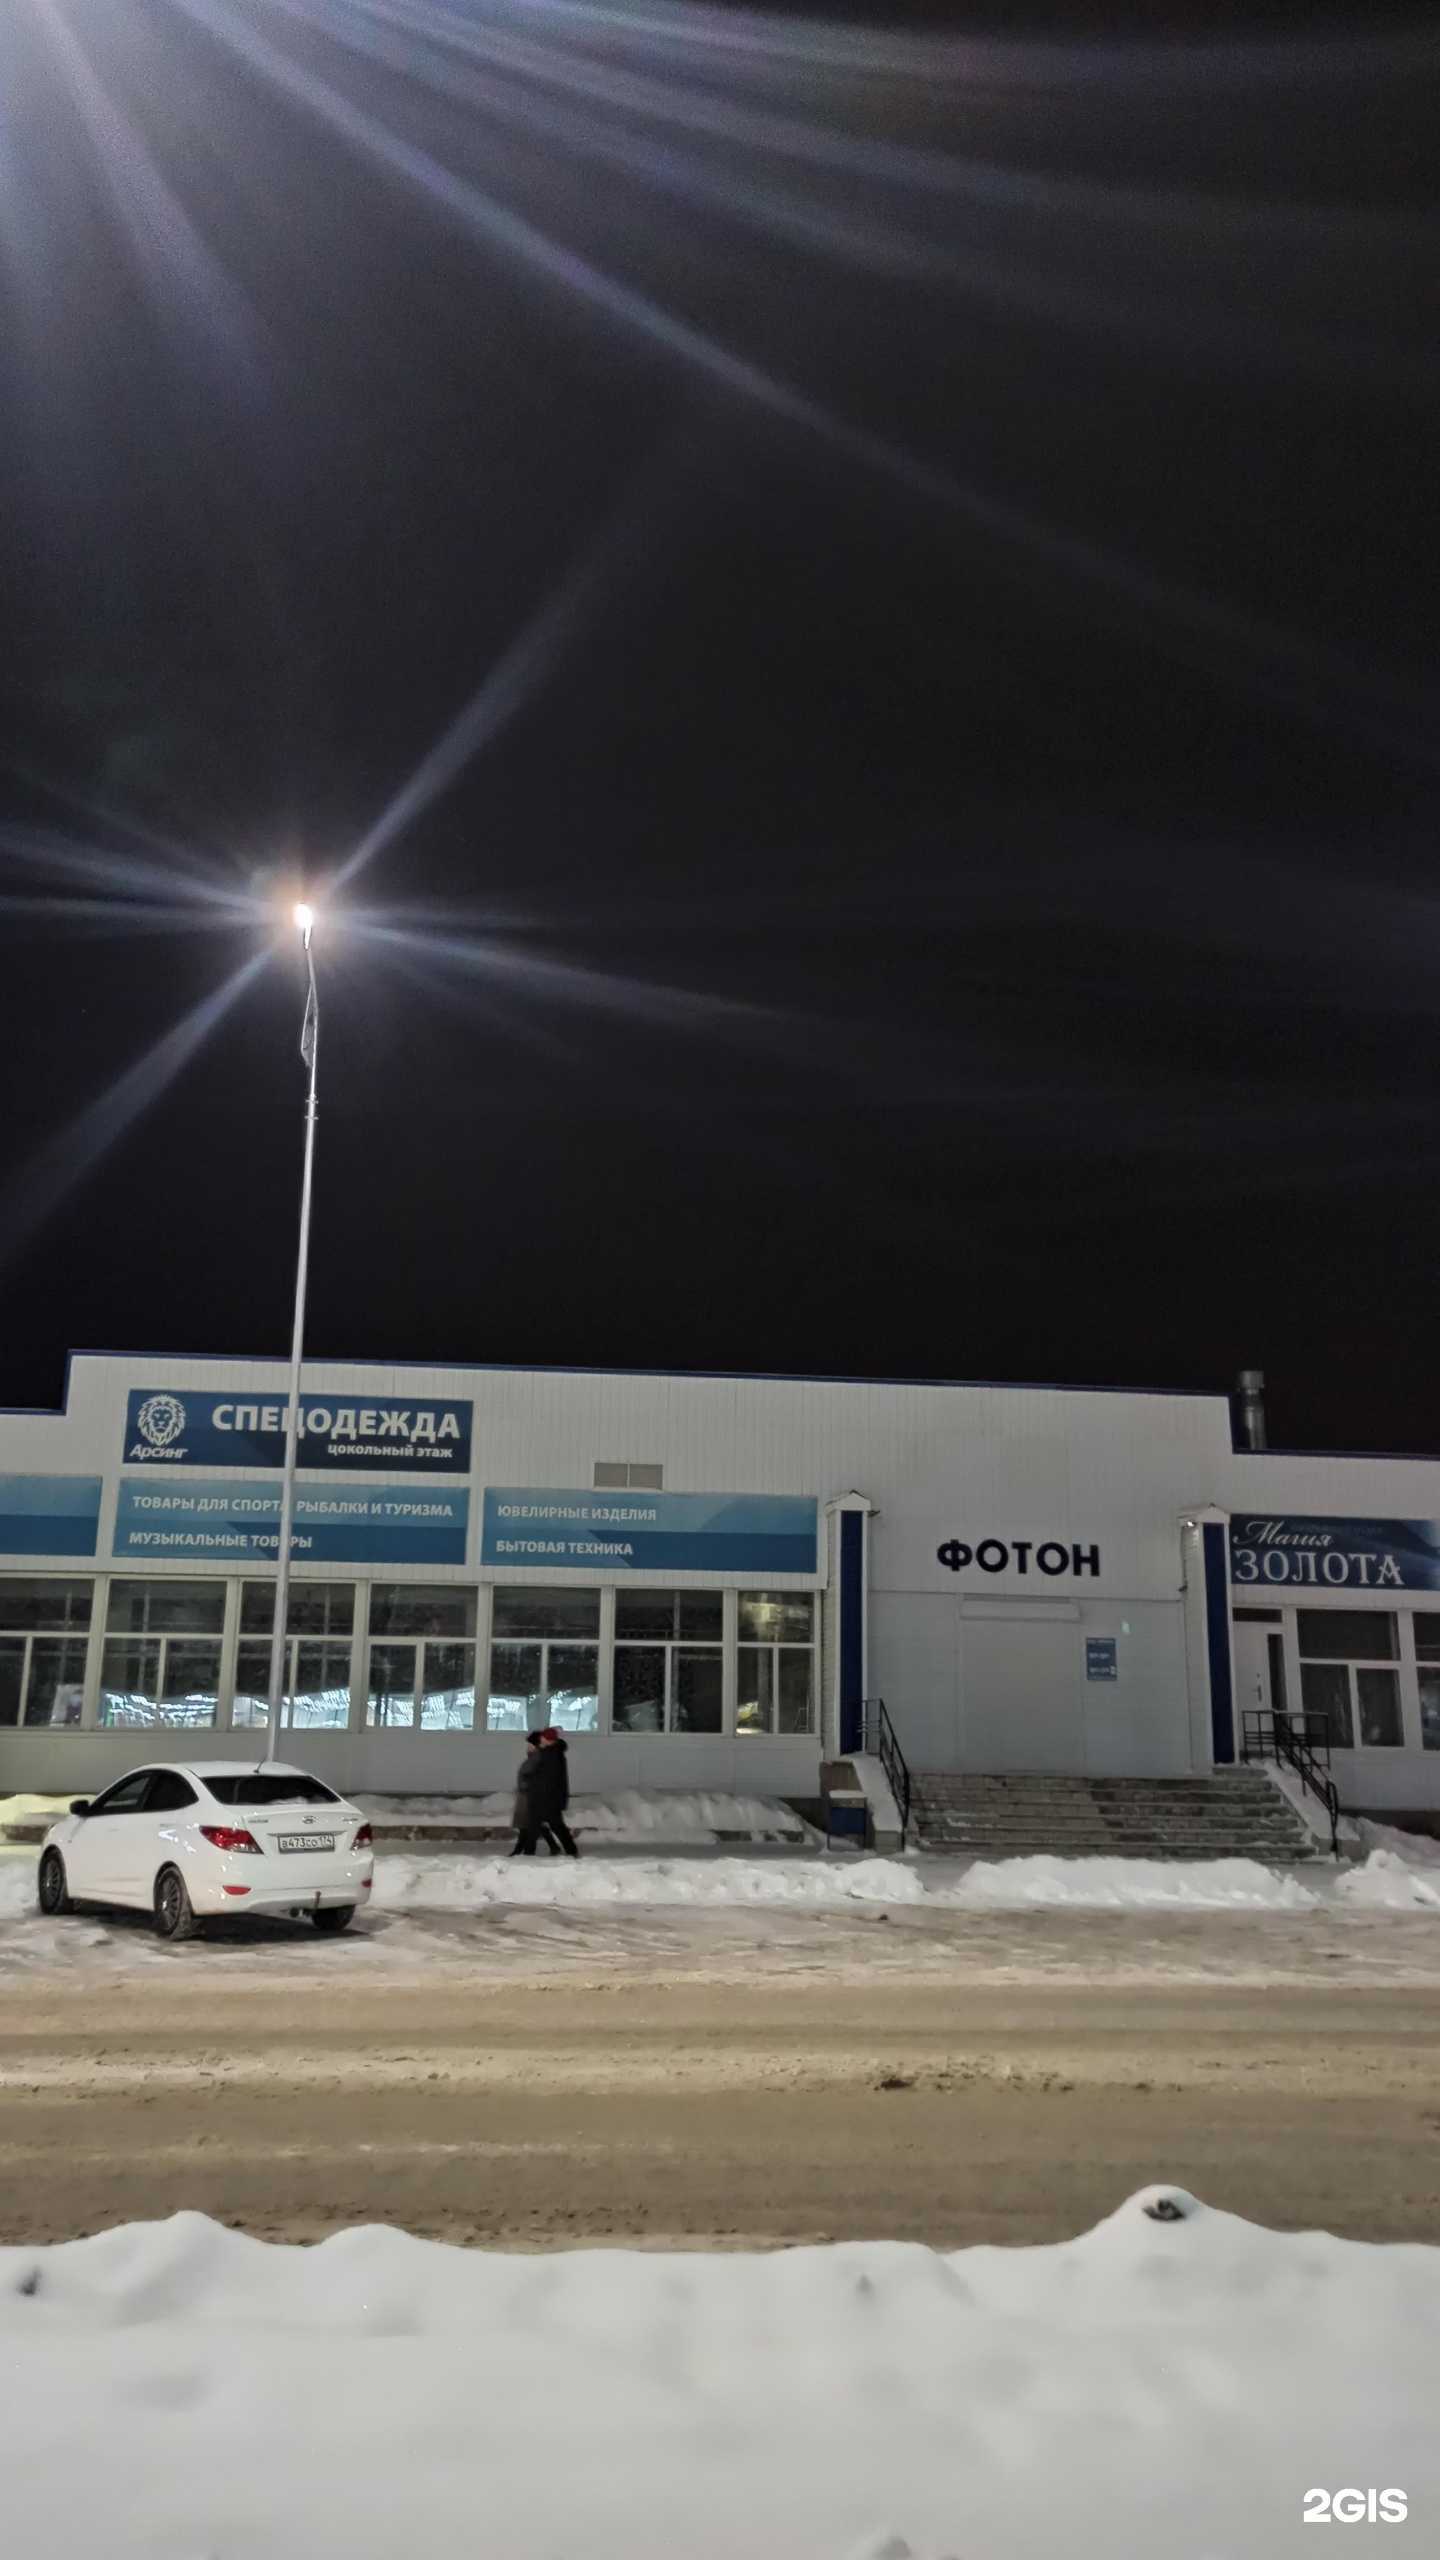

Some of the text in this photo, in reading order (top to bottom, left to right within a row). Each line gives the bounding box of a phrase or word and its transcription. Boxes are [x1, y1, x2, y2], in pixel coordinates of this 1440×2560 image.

[212, 1404, 461, 1443] СПЕЦОДЕЖДА
[130, 1444, 188, 1460] Арсинг
[328, 1444, 453, 1458] цокольный этаж
[132, 1496, 194, 1510] ТОВАРЫ
[197, 1498, 228, 1512] ДЛЯ
[296, 1500, 368, 1514] РЫБАЛКИ
[371, 1503, 382, 1514] И
[385, 1503, 453, 1516] ТУРИЗМА
[497, 1504, 656, 1521] ЮВЕЛИРНЫЕ ИЗДЕЛИЯ
[129, 1532, 312, 1548] МУЗЫКАЛЬНЫЕ ТОВРЫ
[1233, 1520, 1333, 1547] Магия
[495, 1539, 633, 1555] БЫТОВАЯ ТЕХНИКА
[937, 1538, 1100, 1577] ФОТОН
[1235, 1549, 1405, 1586] ЗОЛОТА
